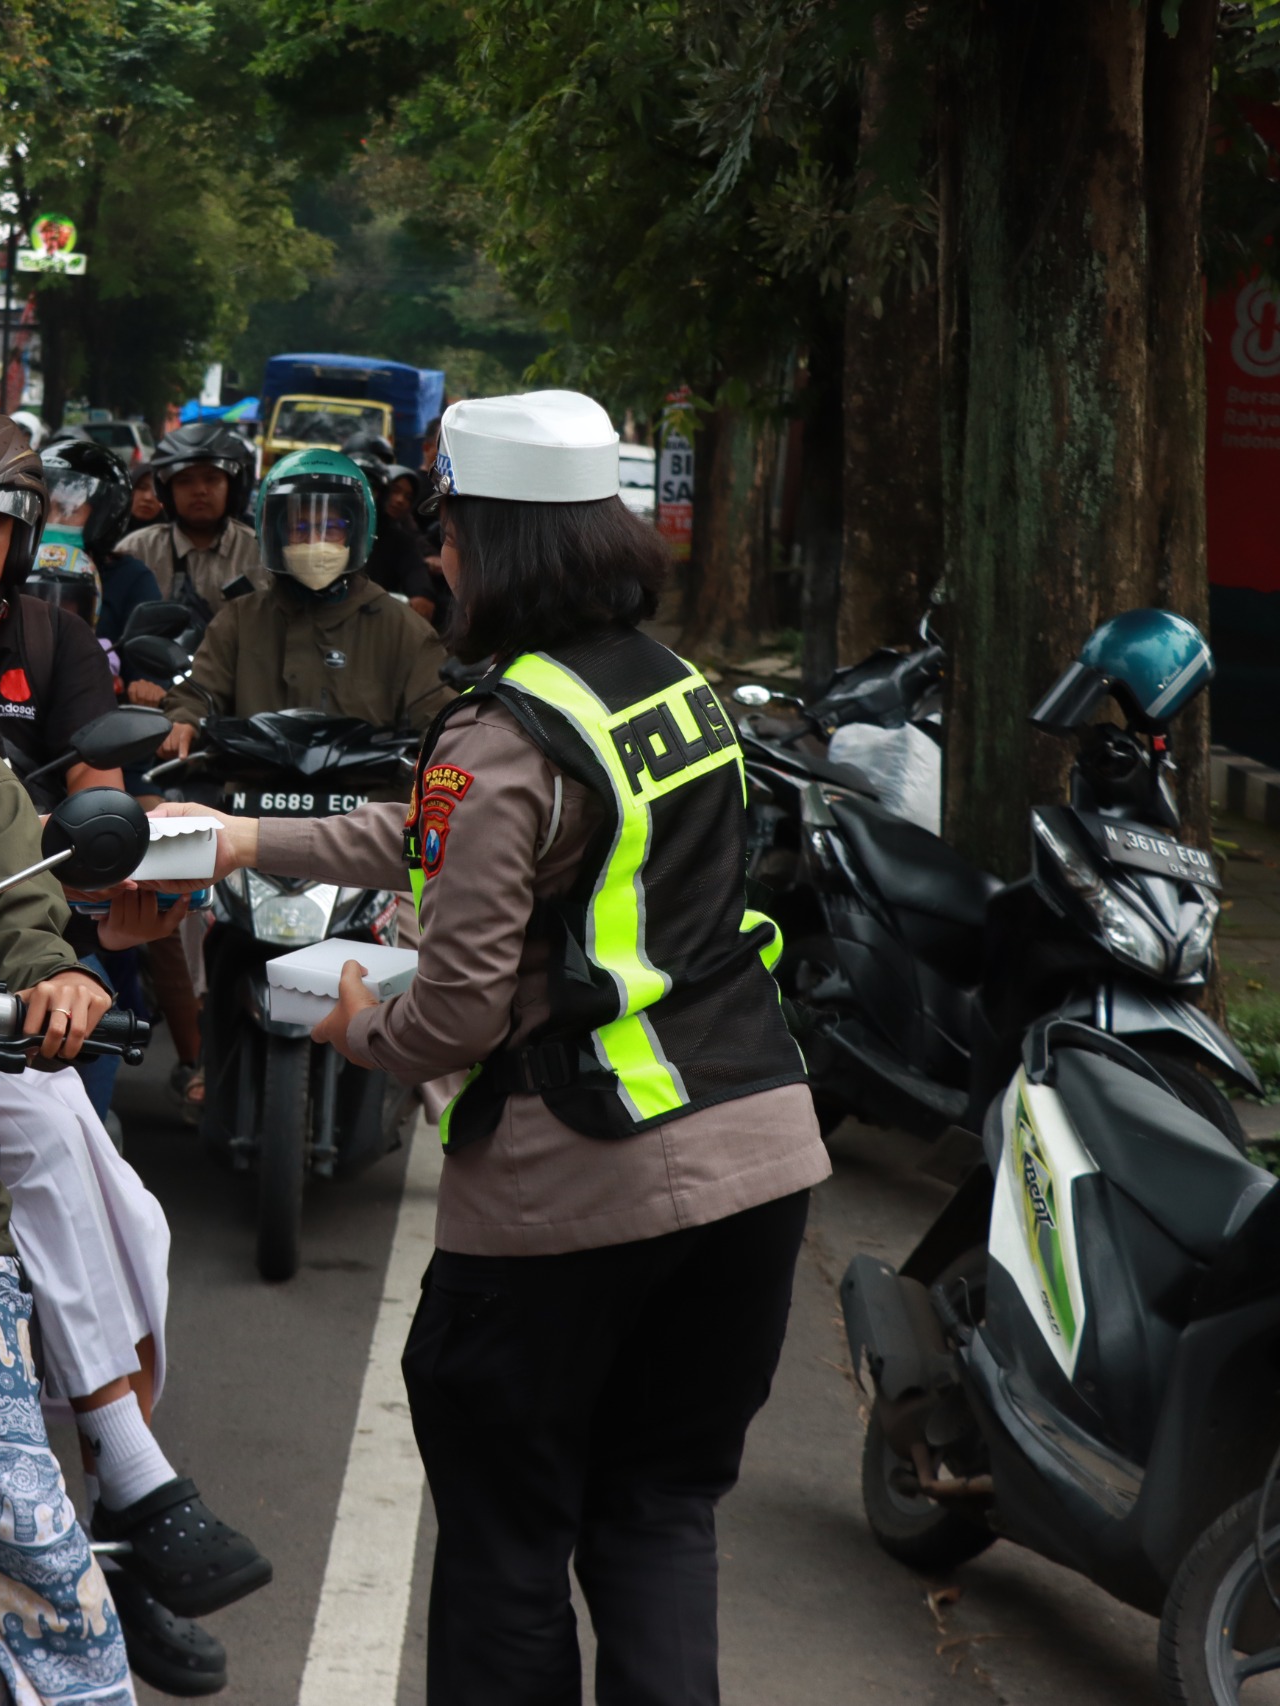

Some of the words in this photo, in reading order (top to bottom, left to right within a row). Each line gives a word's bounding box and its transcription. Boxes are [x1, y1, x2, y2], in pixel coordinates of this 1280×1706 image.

[426, 768, 467, 786] POLRES
[429, 778, 458, 791] MALANG
[233, 793, 246, 809] N
[260, 793, 314, 811] 6689
[1104, 825, 1118, 842] N
[1176, 845, 1209, 868] ECU
